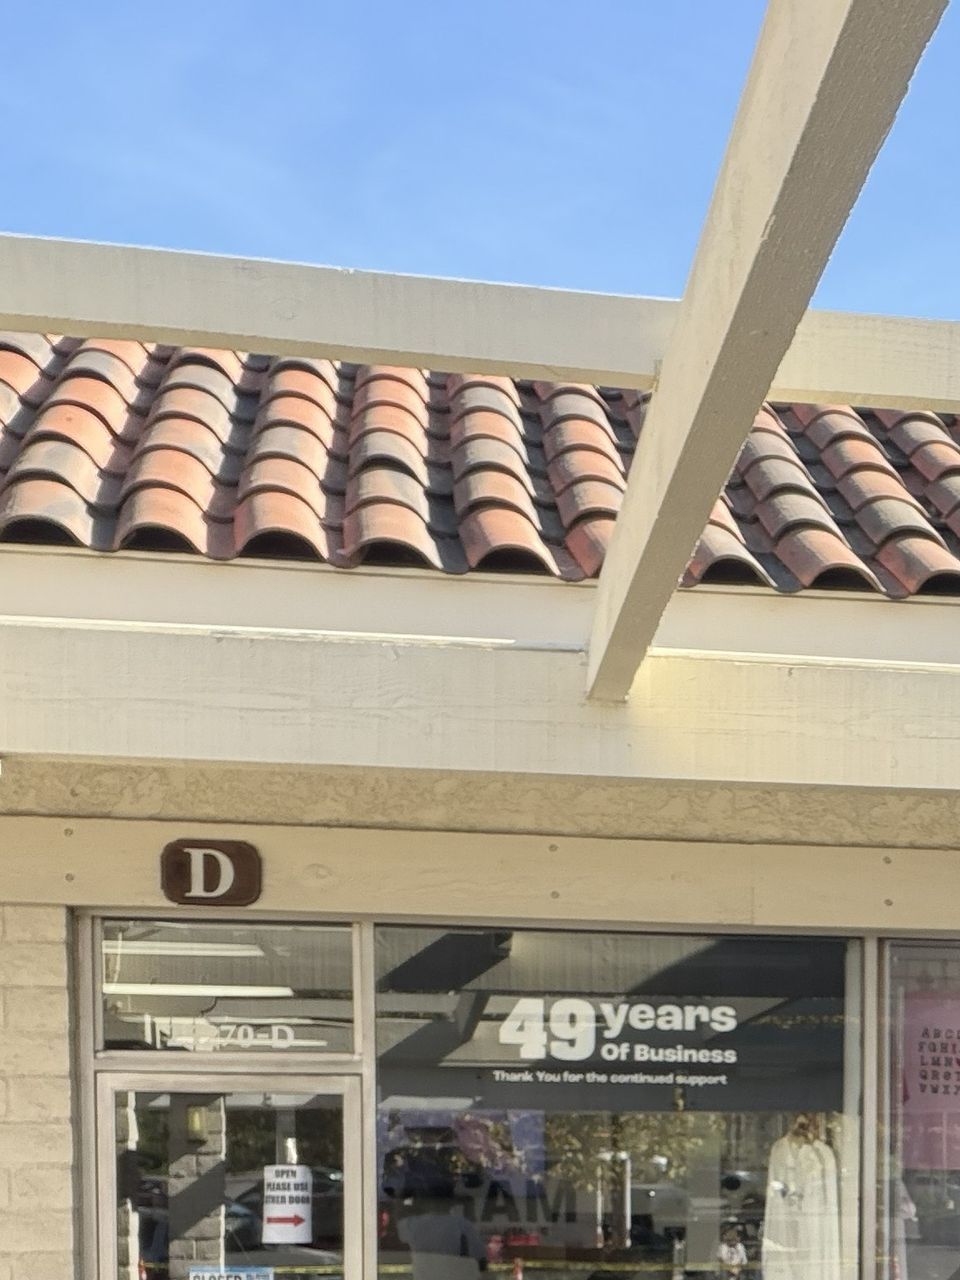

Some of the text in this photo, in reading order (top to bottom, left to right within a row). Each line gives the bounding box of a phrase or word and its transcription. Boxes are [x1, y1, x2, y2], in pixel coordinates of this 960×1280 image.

[184, 848, 235, 898] D
[499, 998, 596, 1061] 49
[600, 1003, 738, 1039] years
[600, 1043, 737, 1063] Of Business
[493, 1070, 727, 1087] Thank You for the continued support
